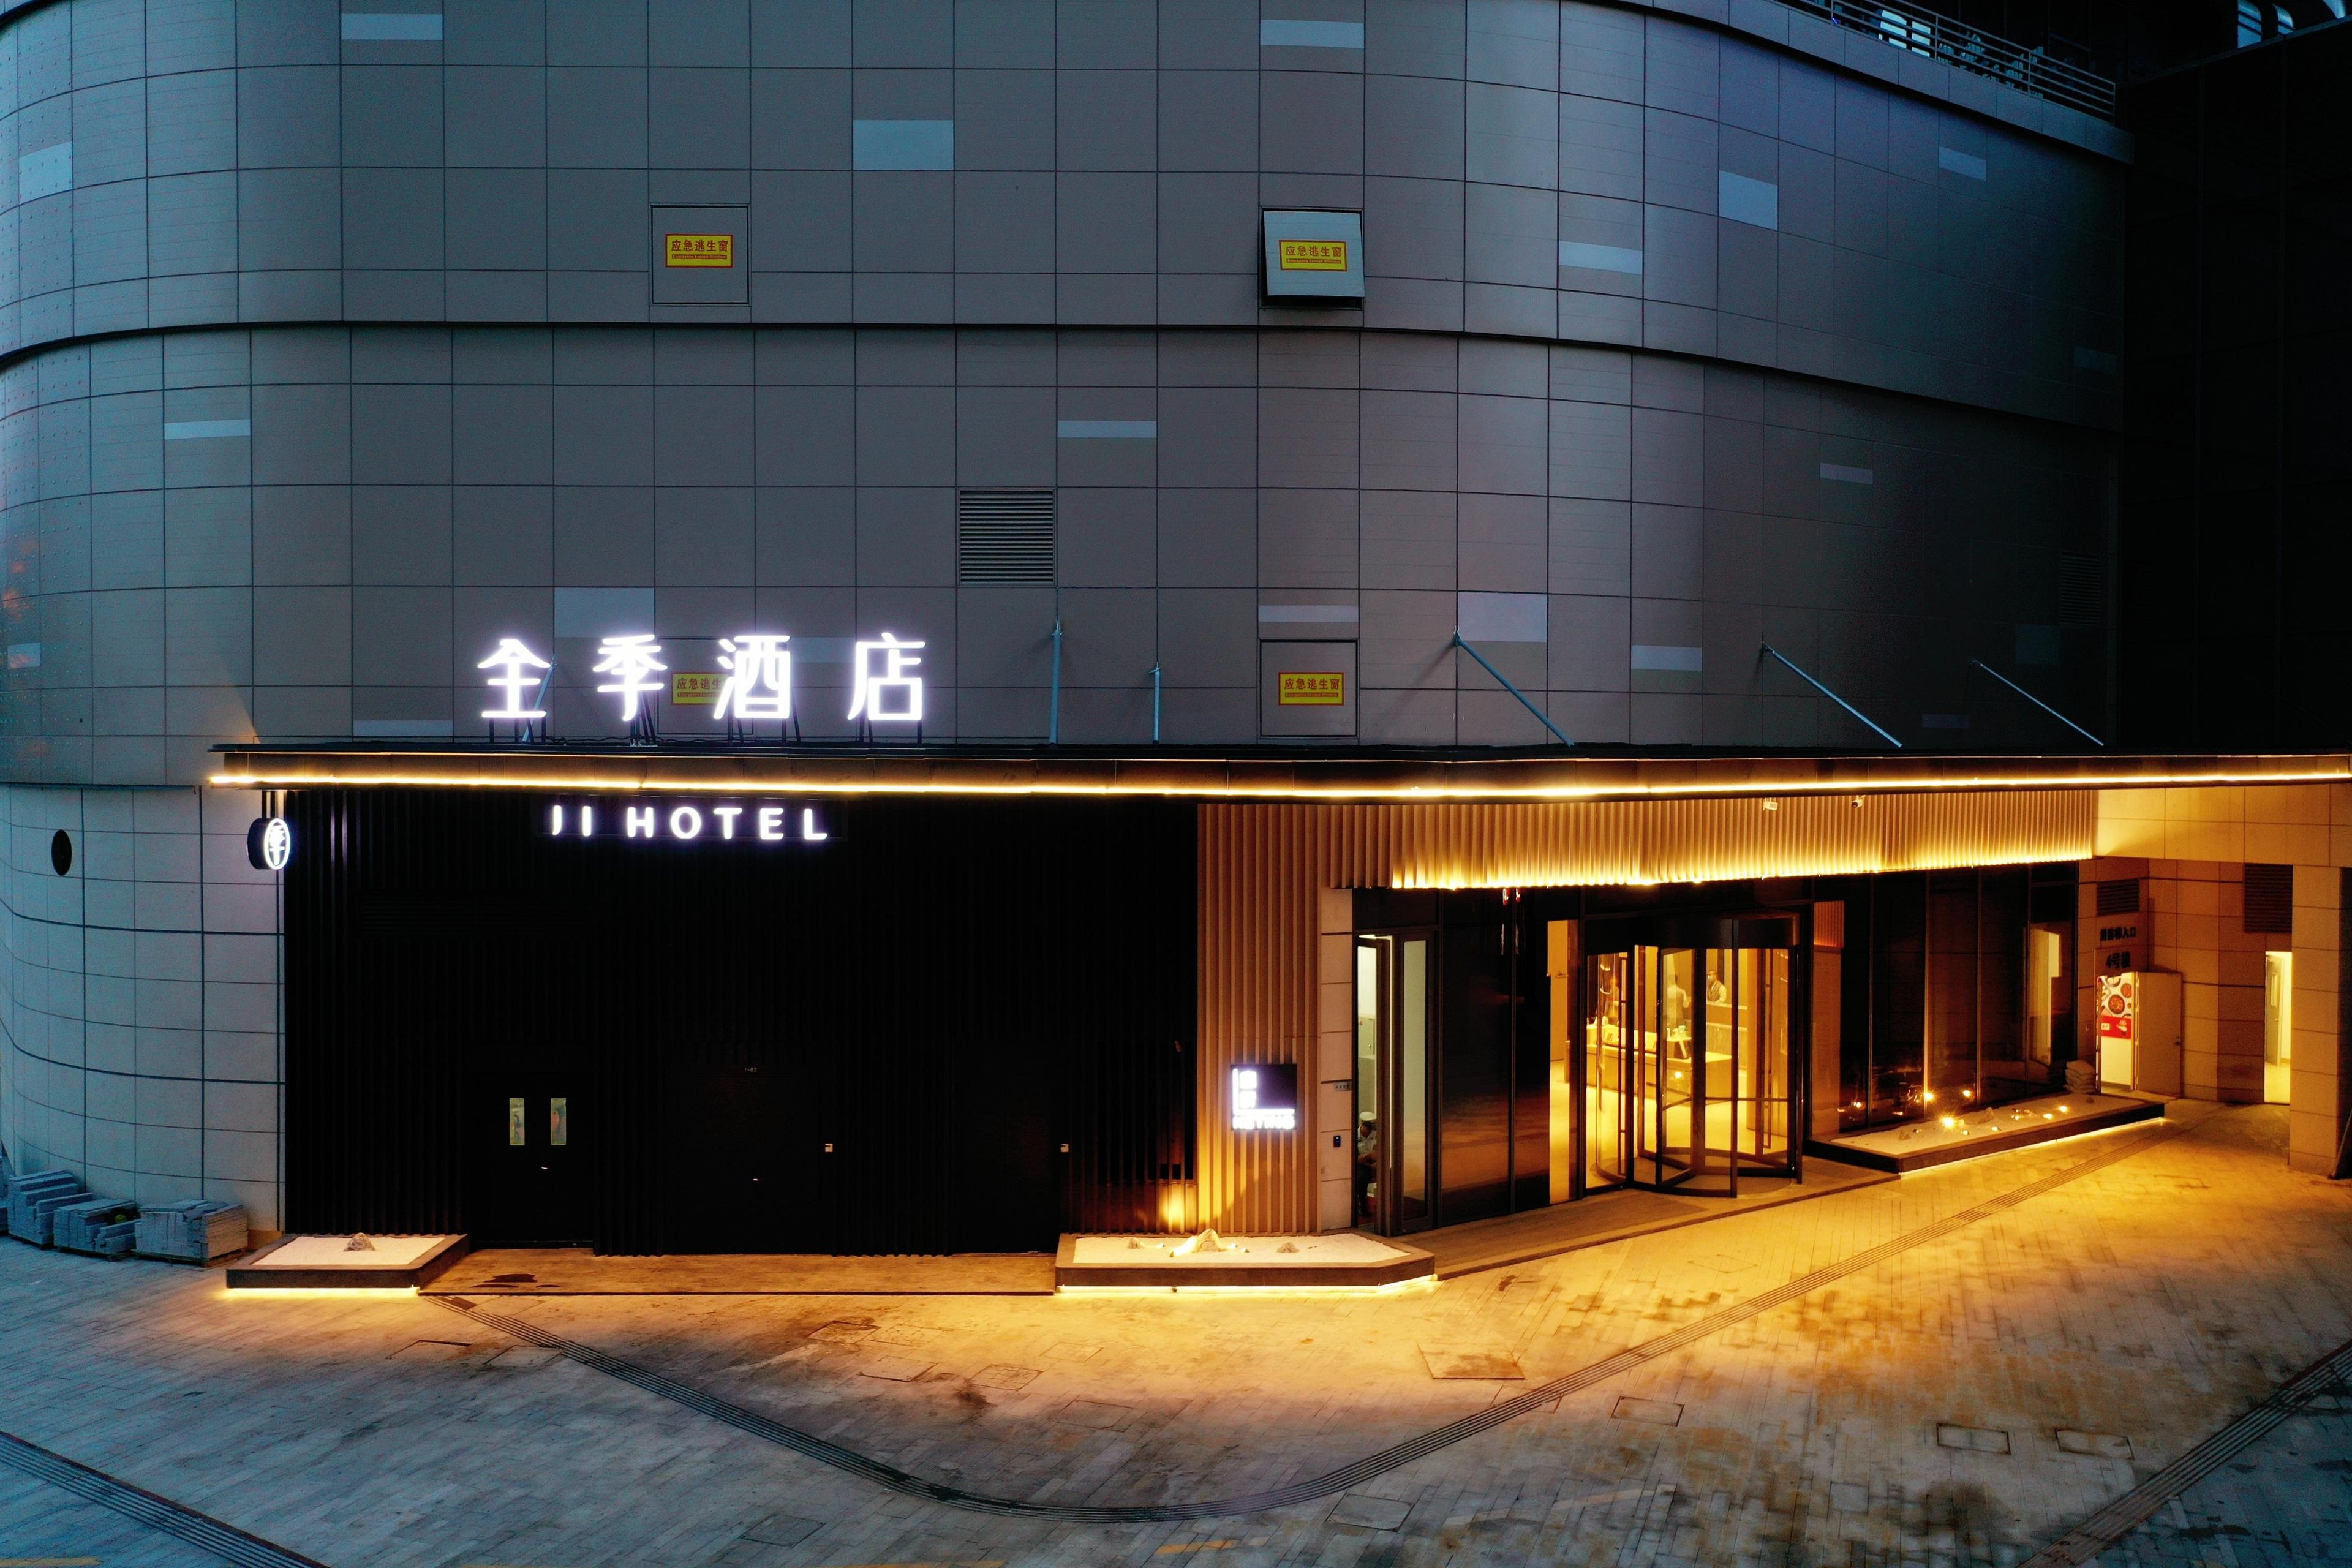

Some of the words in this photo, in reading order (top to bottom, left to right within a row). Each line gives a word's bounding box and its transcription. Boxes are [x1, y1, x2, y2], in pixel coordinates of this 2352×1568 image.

[671, 239, 728, 252] 应急逃生窗
[1286, 245, 1342, 257] 应急逃生窗
[477, 632, 927, 721] 全季酒店
[677, 677, 724, 690] 应急逃生
[1284, 677, 1340, 690] 应急逃生窗
[551, 804, 592, 837] JI
[626, 805, 828, 841] HOTEL
